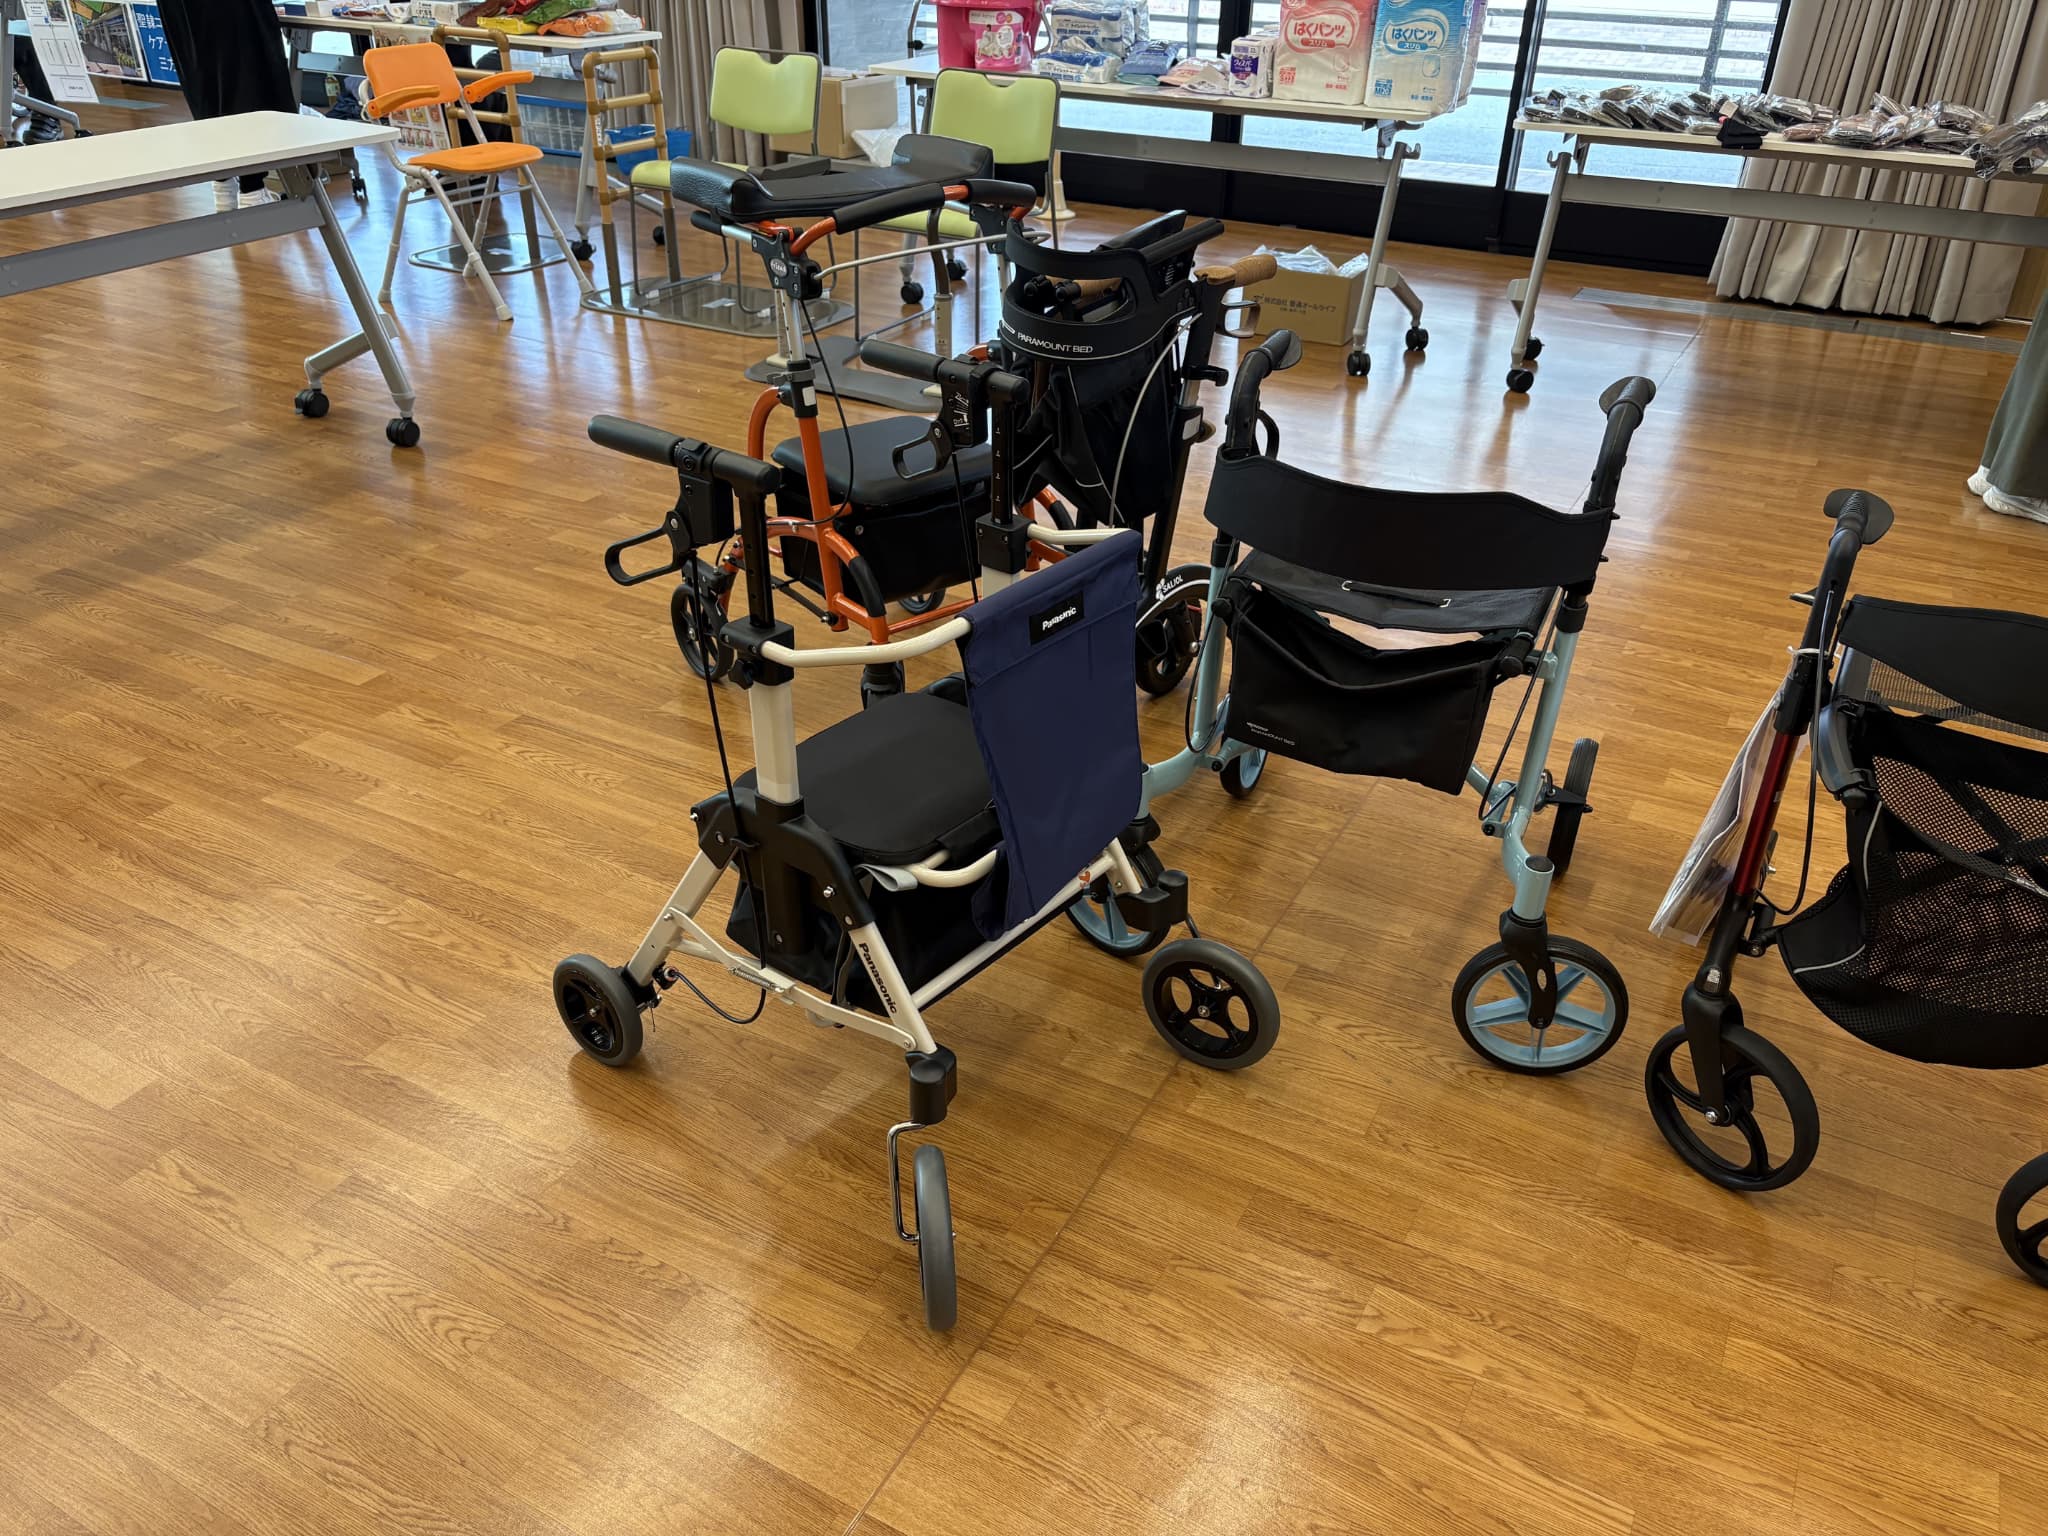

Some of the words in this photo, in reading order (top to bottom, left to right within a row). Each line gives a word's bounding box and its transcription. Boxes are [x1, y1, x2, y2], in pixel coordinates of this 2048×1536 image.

[1293, 22, 1346, 38] はくパンツ
[1391, 28, 1437, 42] はくパンツ
[1017, 332, 1073, 353] PARAMOUNT
[1072, 344, 1094, 353] BED
[1042, 606, 1077, 631] Panasonic
[858, 942, 897, 1014] Panasonic
